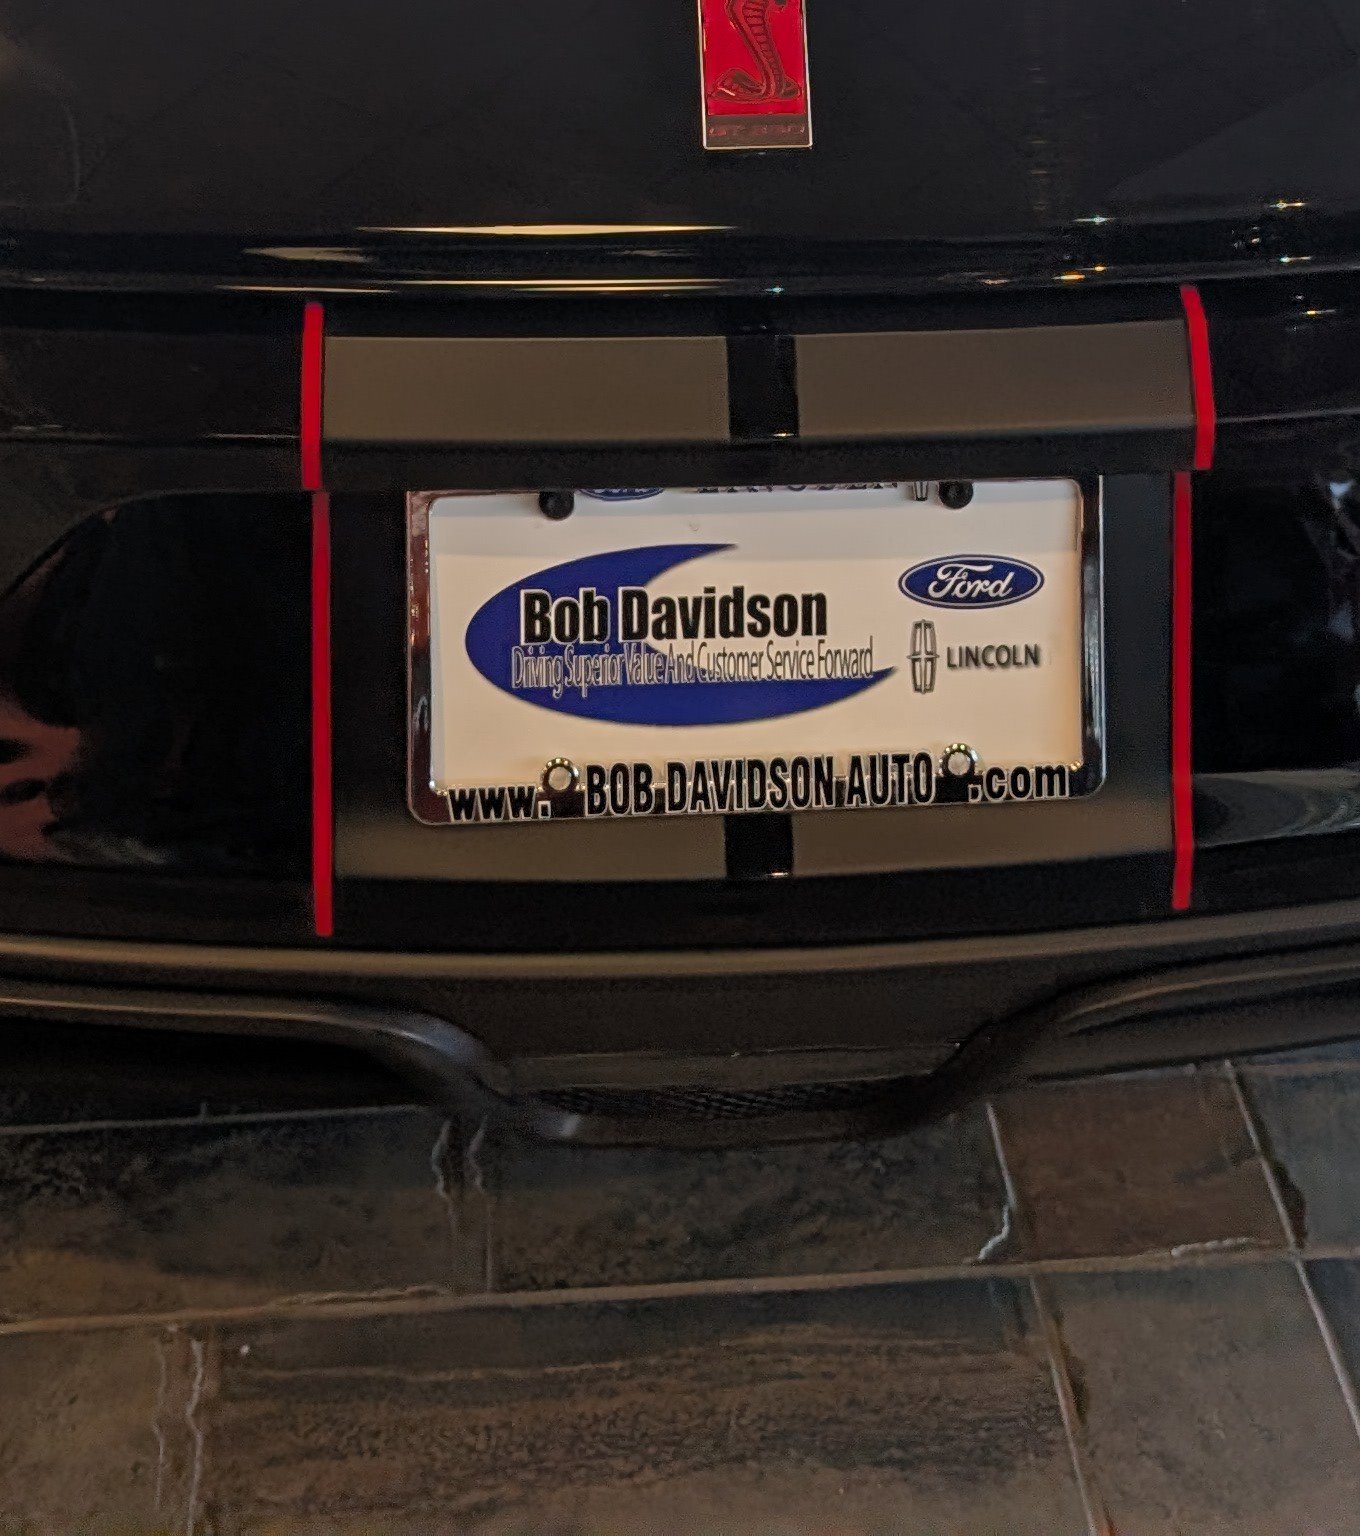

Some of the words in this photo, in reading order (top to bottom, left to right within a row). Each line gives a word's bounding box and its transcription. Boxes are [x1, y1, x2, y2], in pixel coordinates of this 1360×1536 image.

[928, 564, 1015, 599] Ford
[521, 587, 610, 645] Bob
[618, 585, 828, 642] Davidson
[512, 644, 563, 698] Driving
[565, 644, 623, 697] Superior
[622, 642, 666, 685] Value
[665, 642, 694, 684] And
[697, 641, 764, 683] Customer
[766, 640, 815, 681] Service
[818, 636, 874, 679] Forward
[947, 644, 1041, 668] LINCOLN
